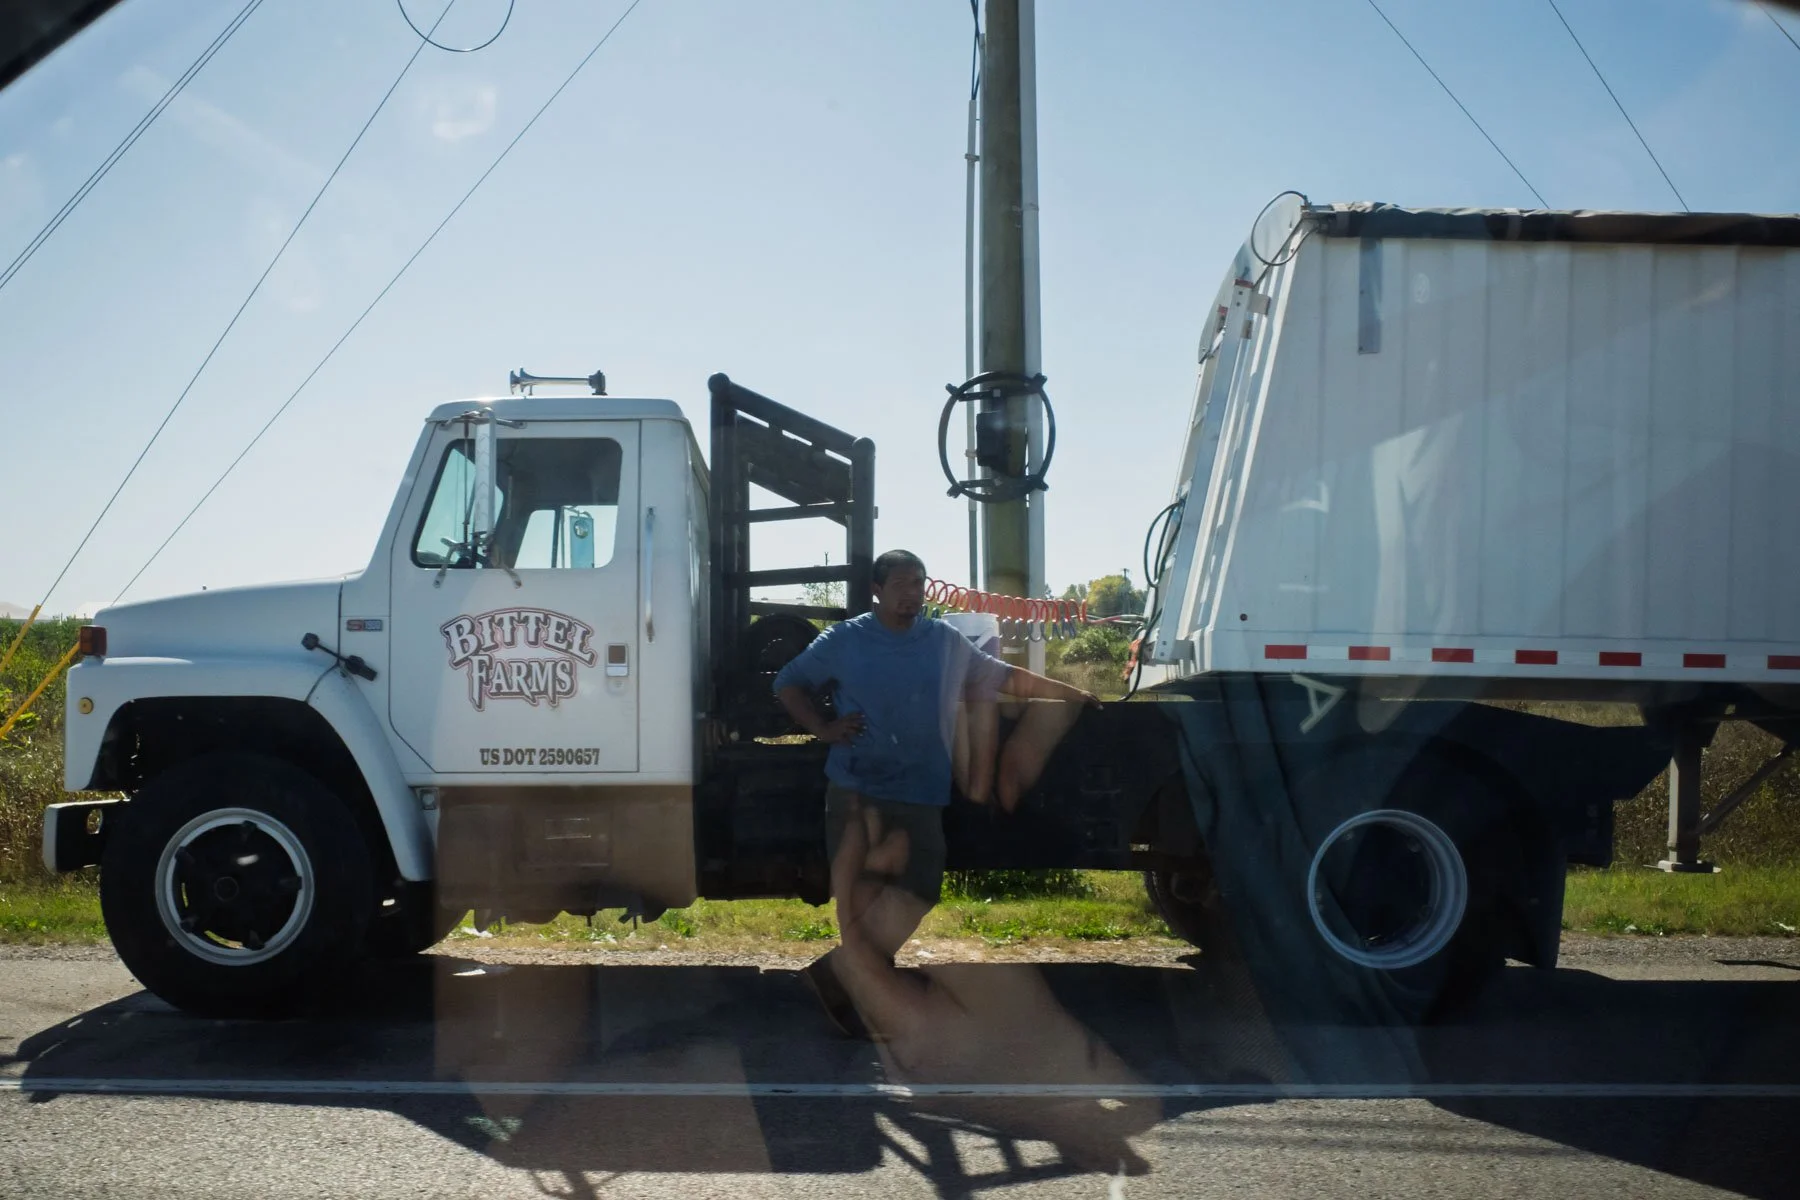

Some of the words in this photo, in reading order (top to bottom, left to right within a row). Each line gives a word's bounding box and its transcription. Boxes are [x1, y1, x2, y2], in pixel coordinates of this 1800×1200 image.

[441, 608, 597, 668] BITTEL
[470, 654, 577, 710] FARMS
[479, 748, 500, 766] US
[503, 748, 536, 766] DOT
[539, 748, 600, 766] 2590657
